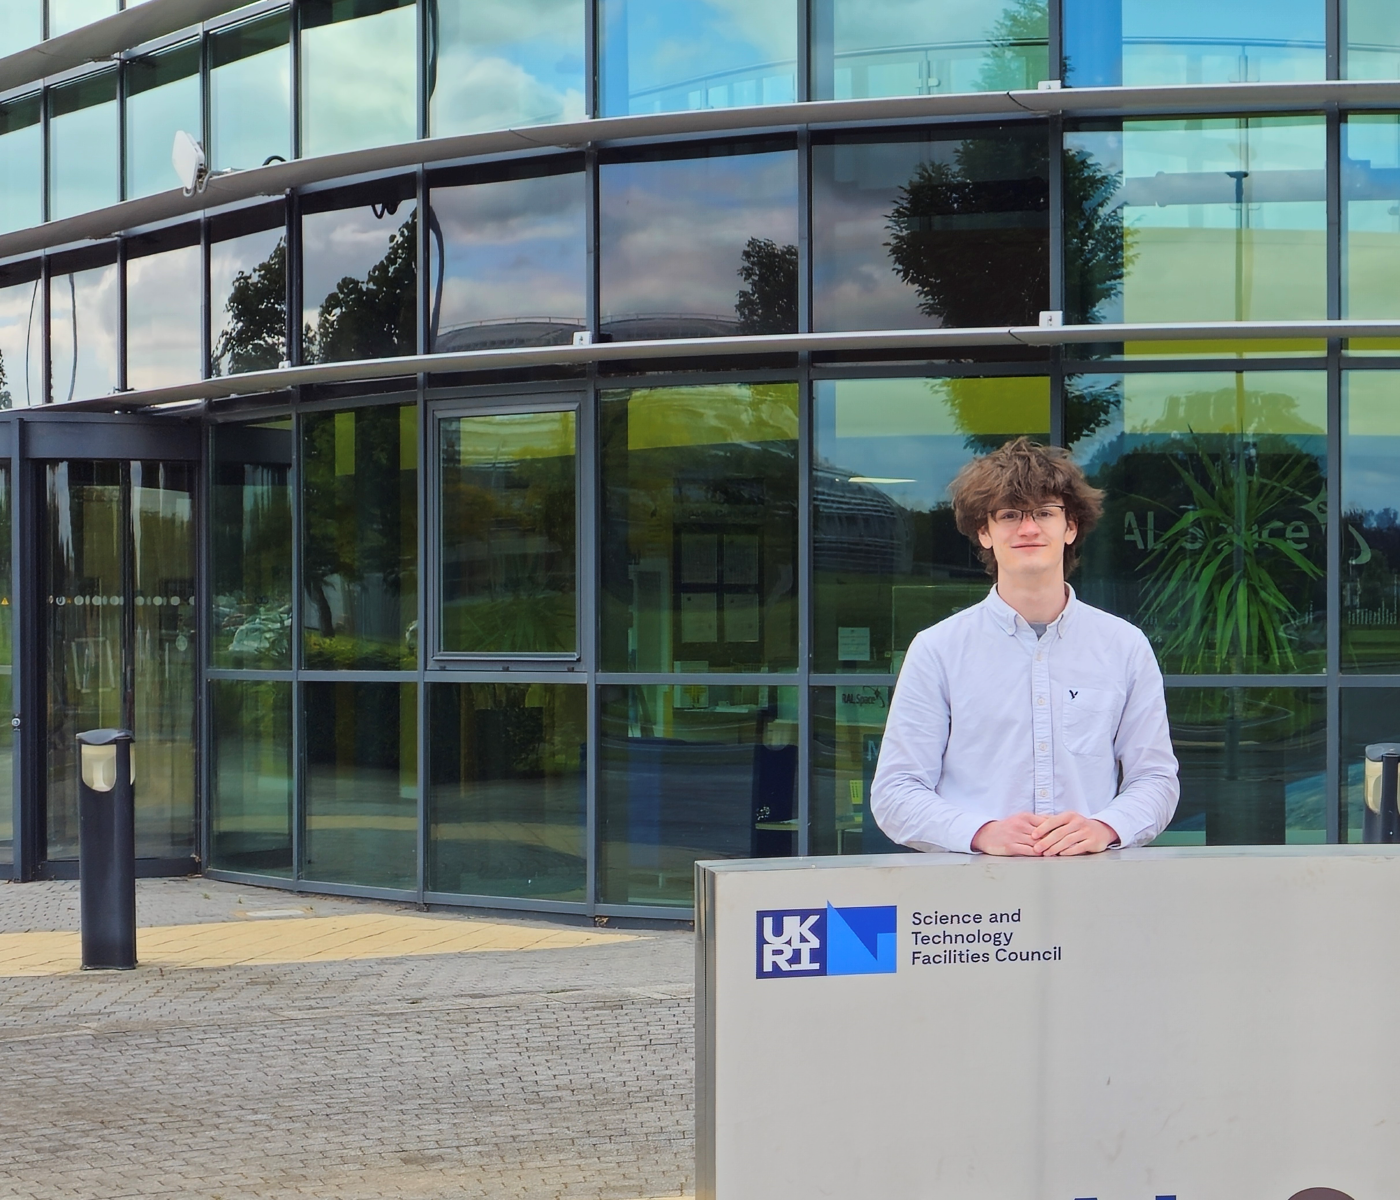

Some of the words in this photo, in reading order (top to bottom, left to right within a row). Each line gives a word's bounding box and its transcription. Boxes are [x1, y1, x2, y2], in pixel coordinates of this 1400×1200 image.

[856, 694, 876, 706] Space
[912, 911, 983, 926] Science
[989, 908, 1021, 923] and
[911, 929, 1013, 946] Technology
[912, 948, 990, 965] Facilities
[995, 946, 1062, 962] Council
